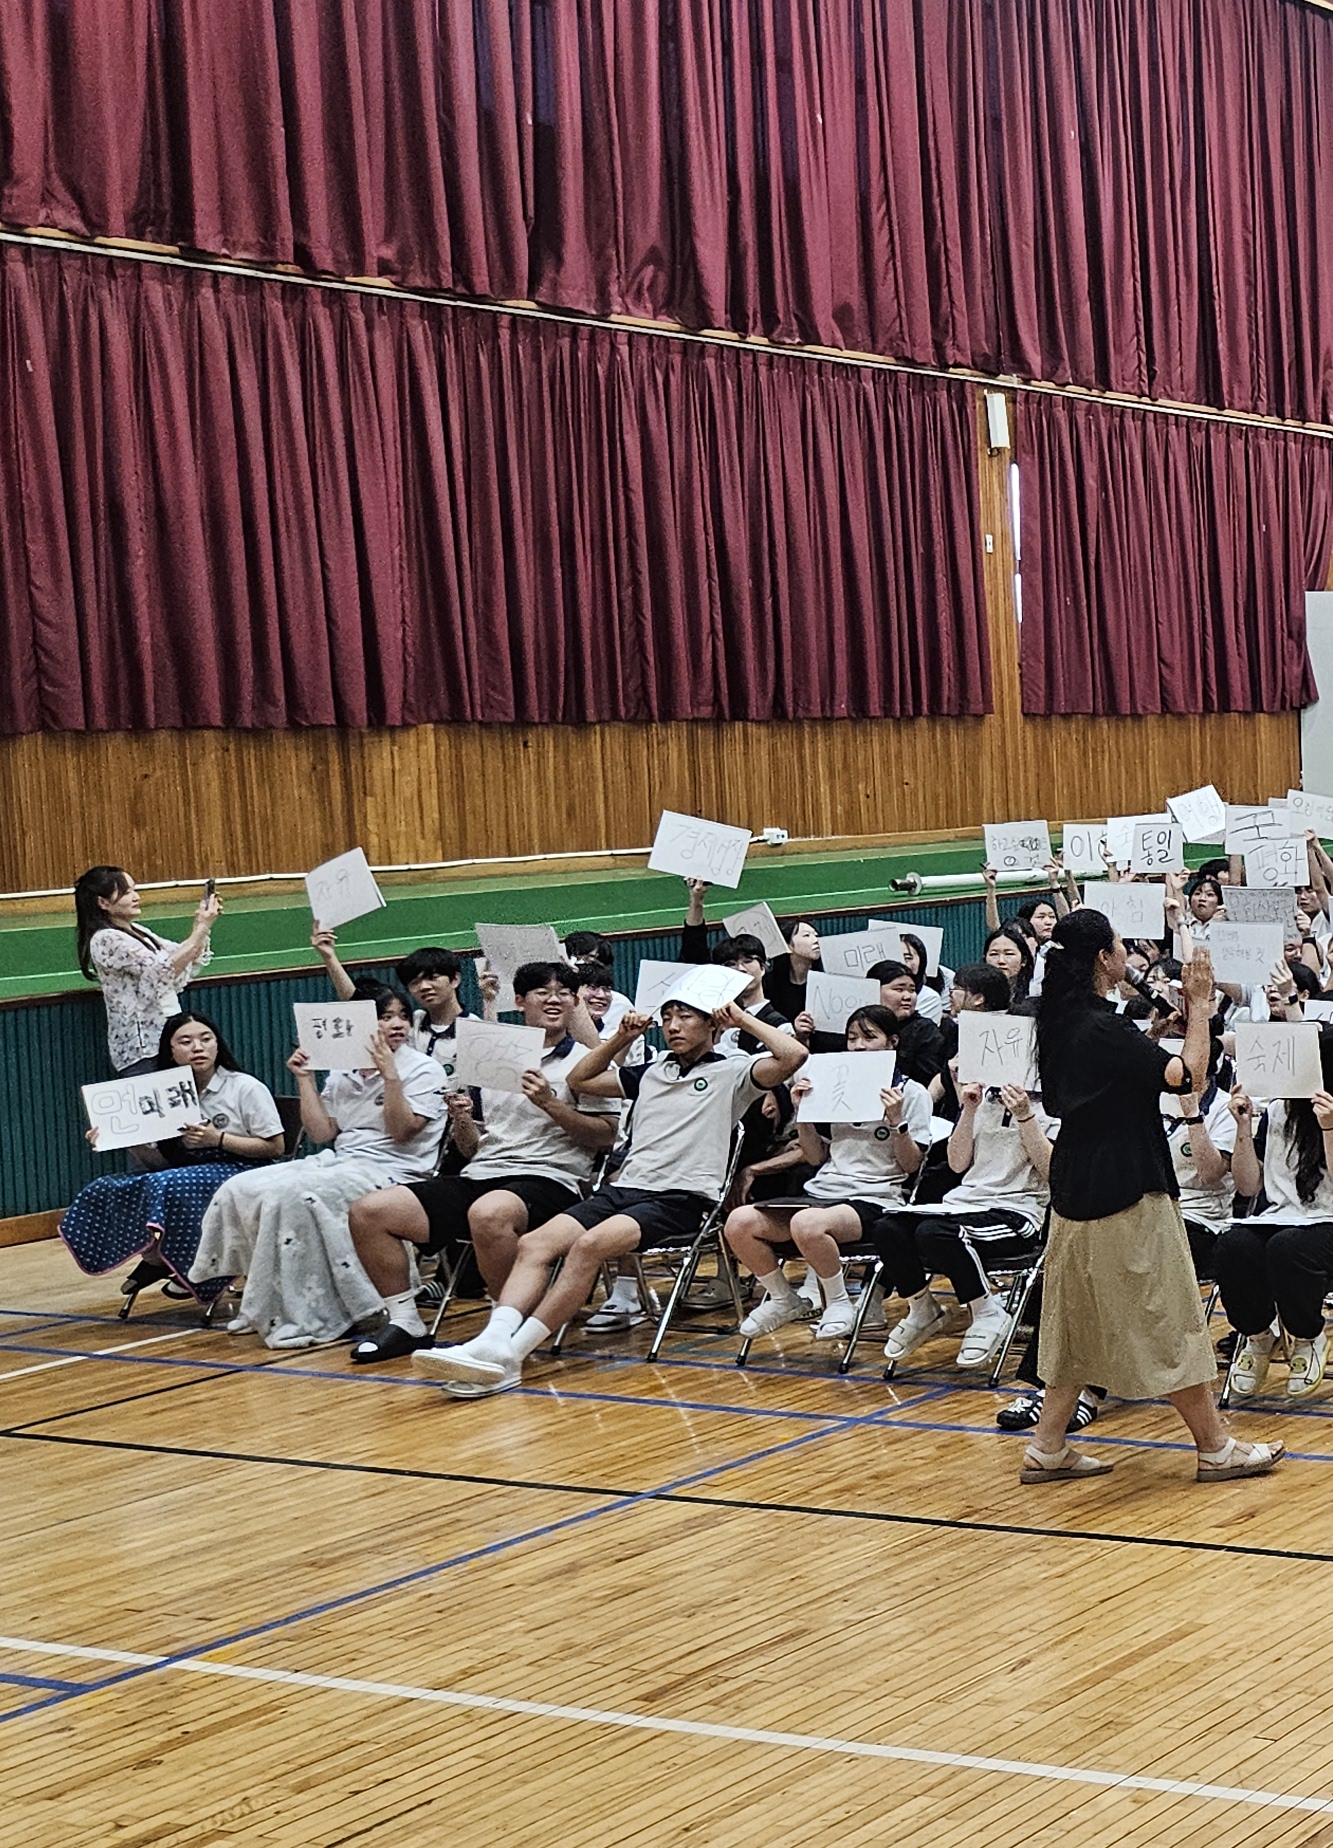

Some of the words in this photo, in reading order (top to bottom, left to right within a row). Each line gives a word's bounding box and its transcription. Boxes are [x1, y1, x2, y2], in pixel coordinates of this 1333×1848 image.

[1140, 829, 1176, 866] 통일
[844, 943, 886, 969] 미래
[311, 1017, 354, 1040] 평화
[979, 1027, 1024, 1067] 자유
[1247, 1035, 1297, 1077] 숙제
